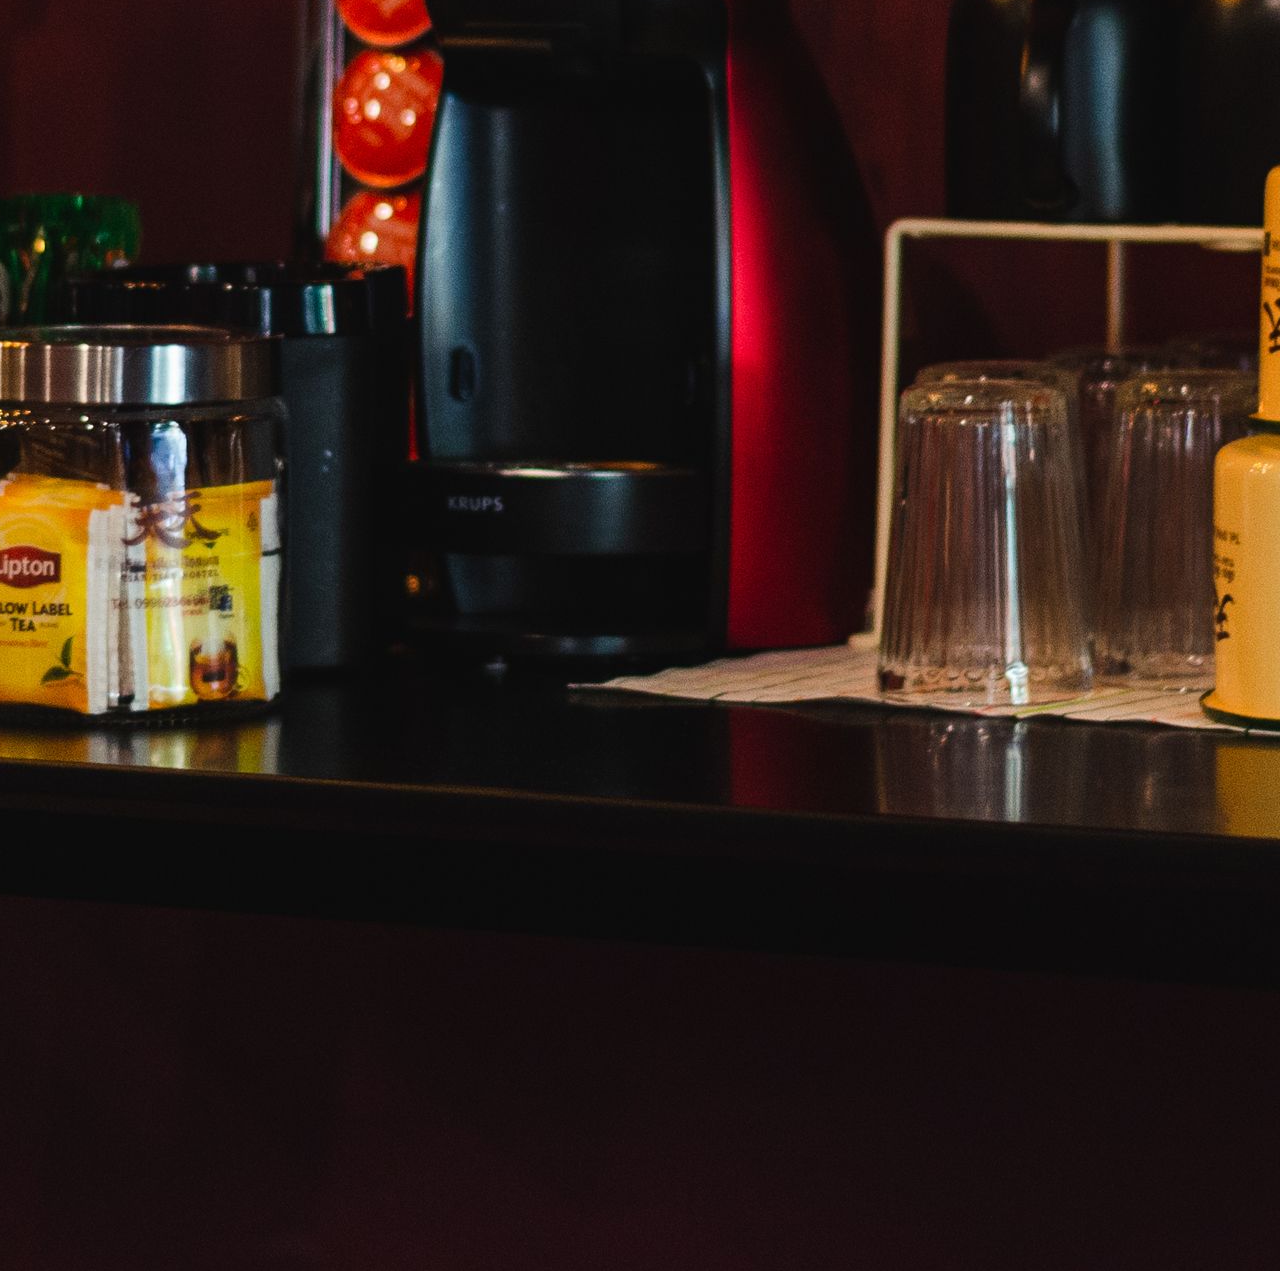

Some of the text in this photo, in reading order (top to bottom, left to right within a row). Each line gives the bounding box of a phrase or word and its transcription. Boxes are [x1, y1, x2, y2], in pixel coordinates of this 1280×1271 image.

[448, 495, 504, 512] KRUPS
[32, 601, 73, 617] LABEL
[9, 617, 37, 633] TEA
